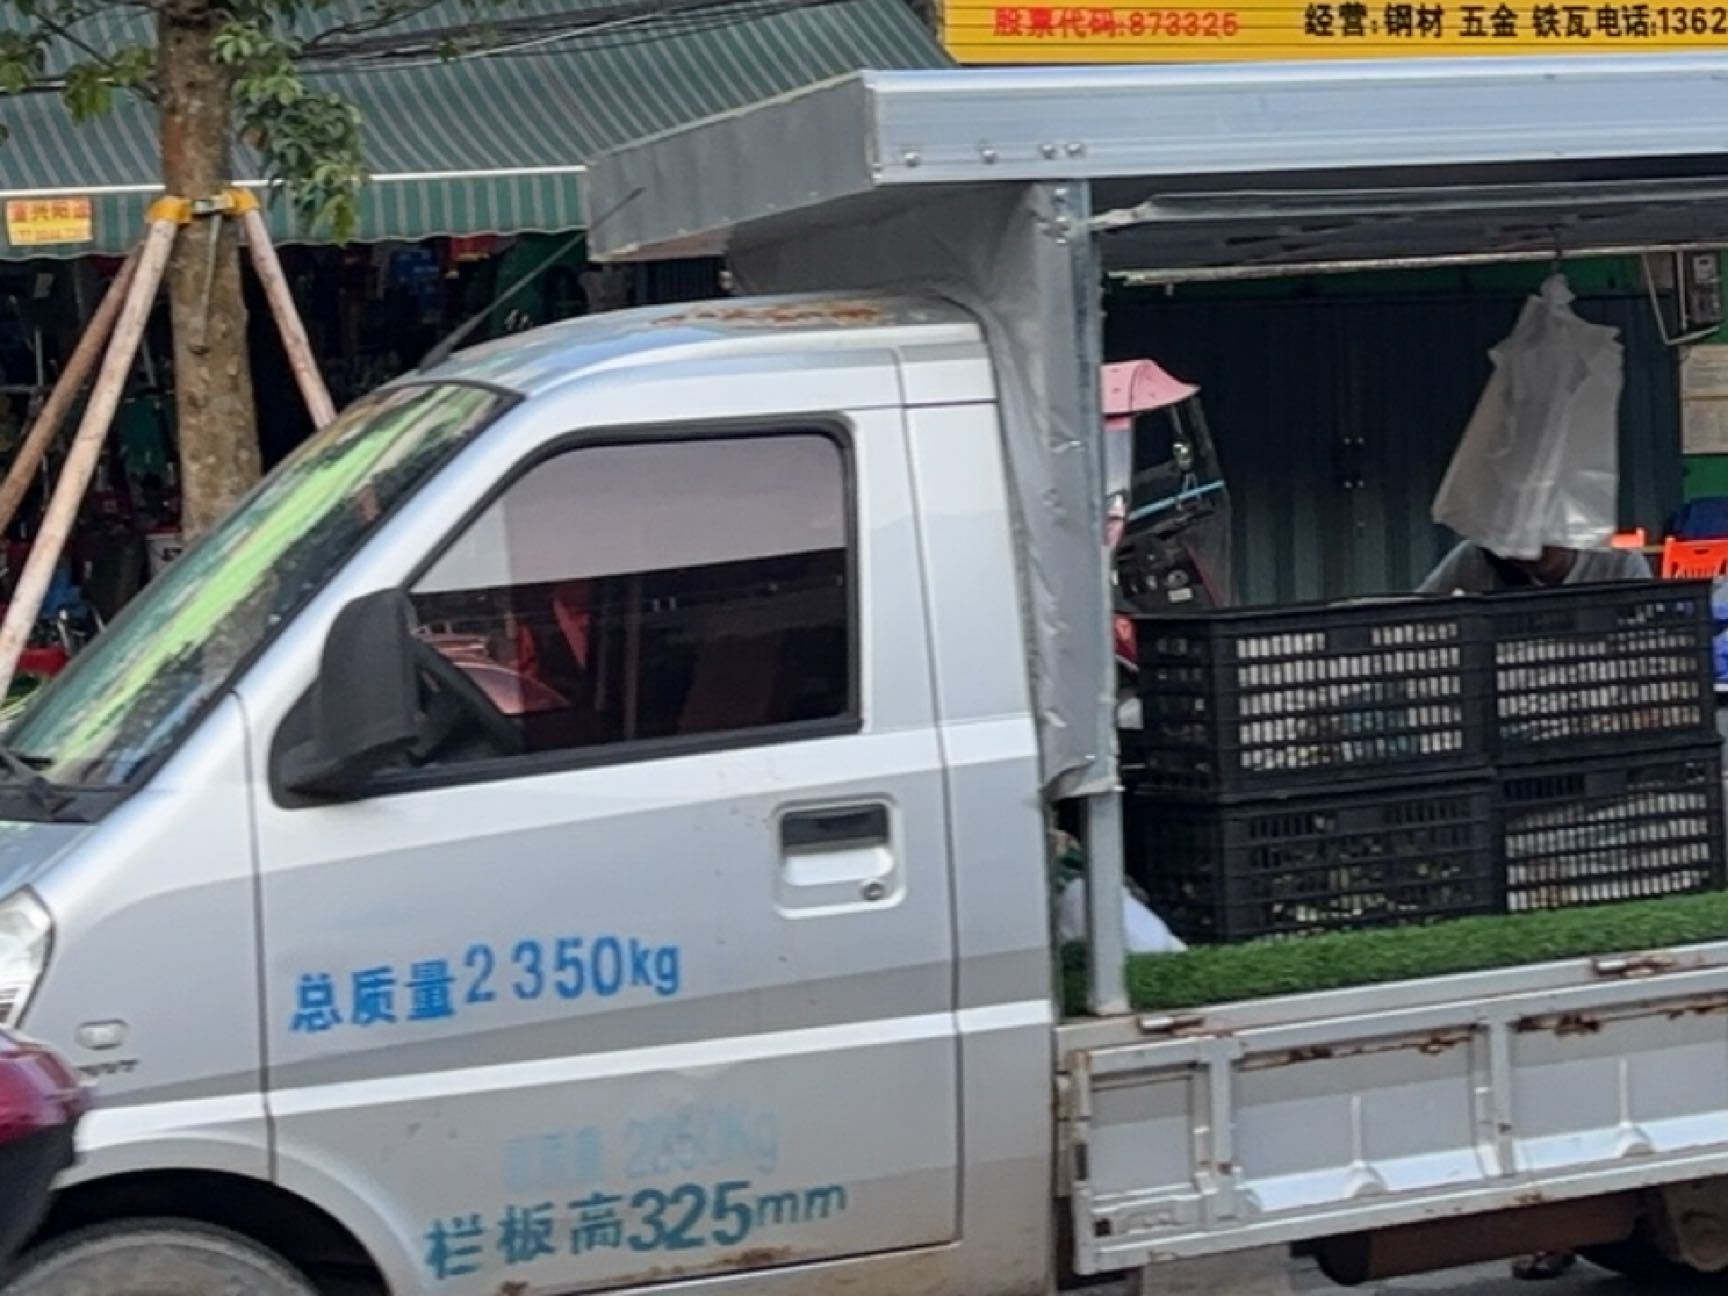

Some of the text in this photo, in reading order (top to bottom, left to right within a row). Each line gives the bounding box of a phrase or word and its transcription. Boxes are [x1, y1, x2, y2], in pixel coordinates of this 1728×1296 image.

[993, 6, 1239, 40] 股票代码:873325
[1304, 2, 1444, 38] 经营:钢材
[1459, 3, 1518, 37] 五金
